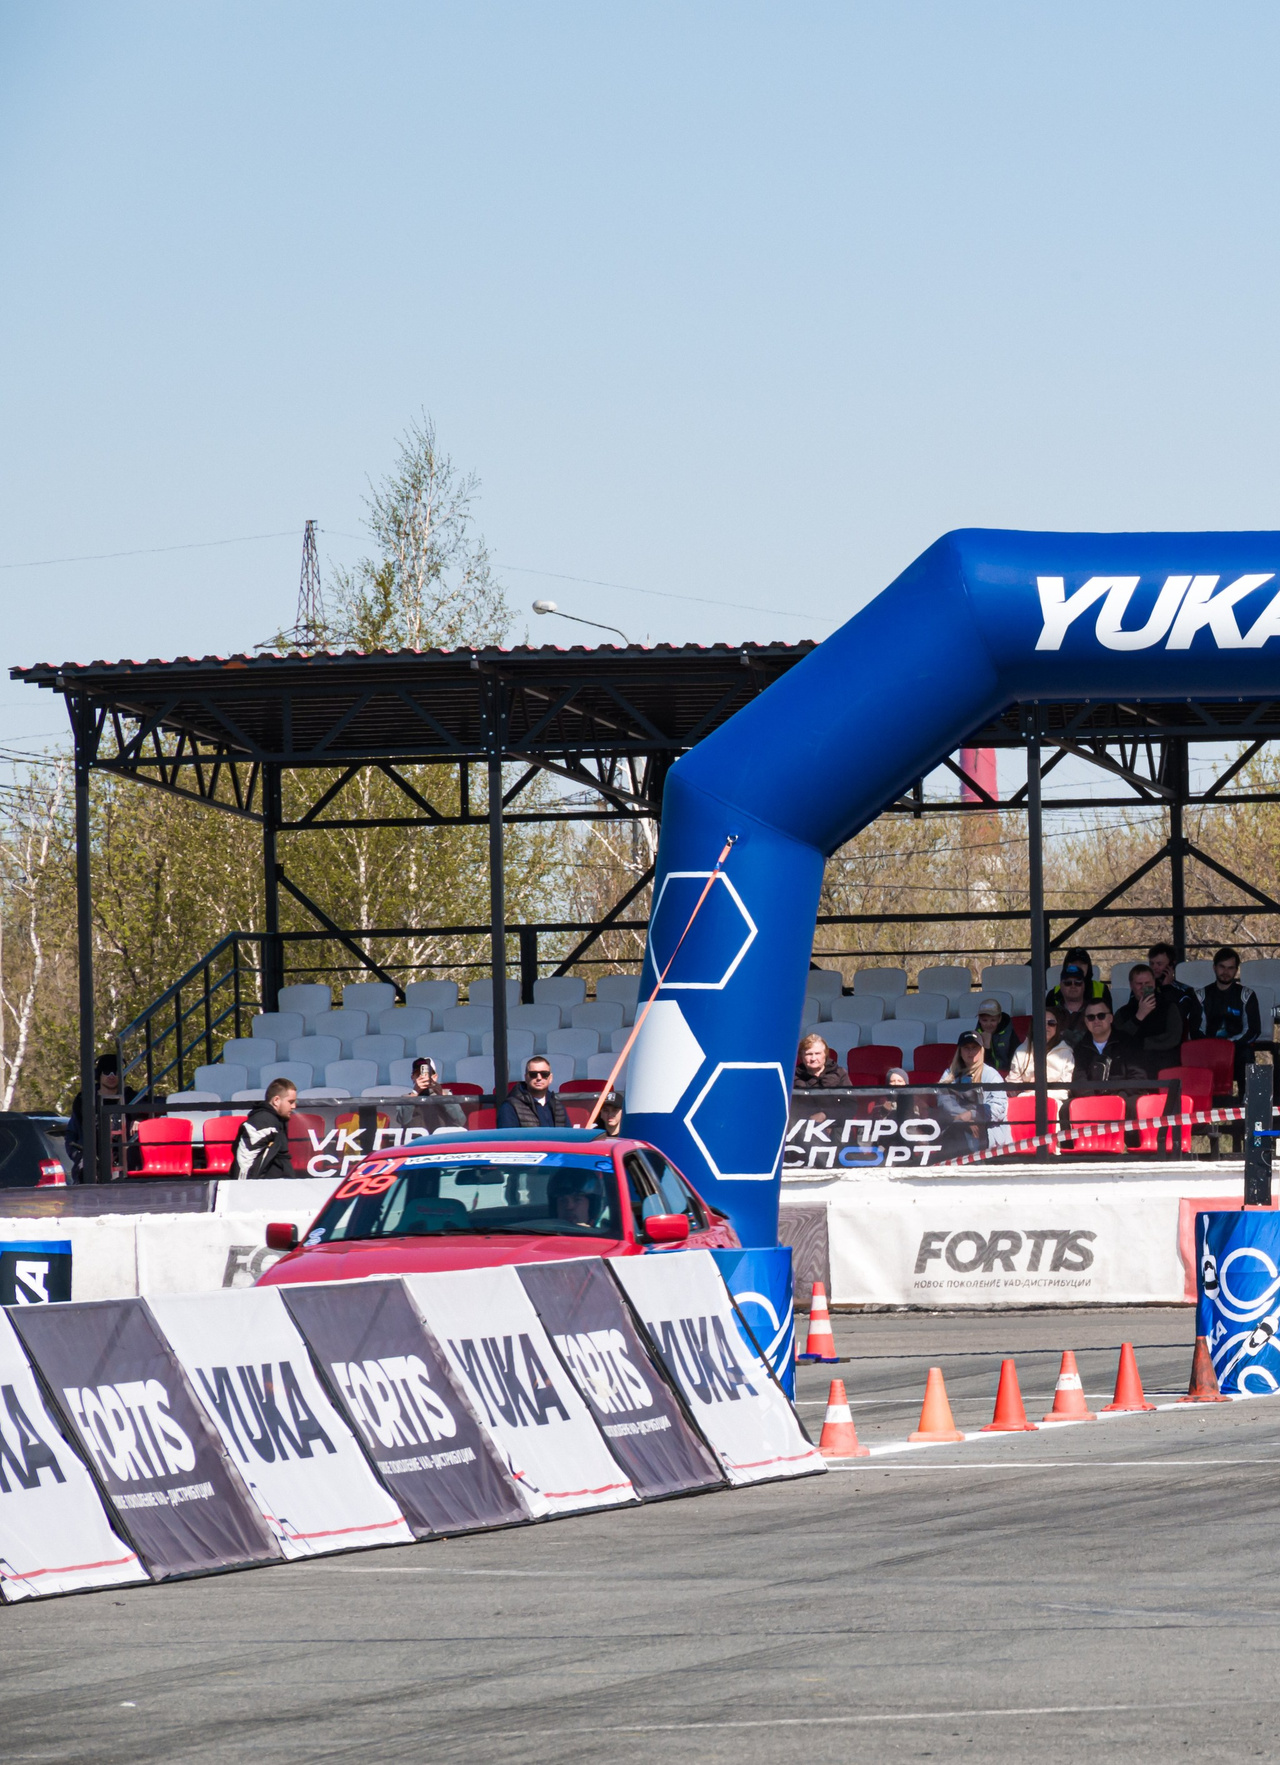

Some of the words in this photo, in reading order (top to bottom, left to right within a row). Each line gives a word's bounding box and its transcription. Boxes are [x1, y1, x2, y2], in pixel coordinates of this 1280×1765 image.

[783, 1145, 942, 1168] СПОРТ
[841, 1118, 941, 1142] ПРО
[336, 1174, 397, 1199] 09
[914, 1229, 1098, 1274] FORTIS
[914, 1280, 944, 1288] НОВОЕ
[947, 1279, 1001, 1288] ПОКОЛЕНИЕ
[330, 1354, 458, 1450] FORTIS
[447, 1332, 572, 1429] YUKA
[552, 1328, 654, 1415] FORTIS
[646, 1314, 760, 1406] YUKA
[62, 1378, 197, 1482] FORTIS
[194, 1360, 338, 1464] YUKA
